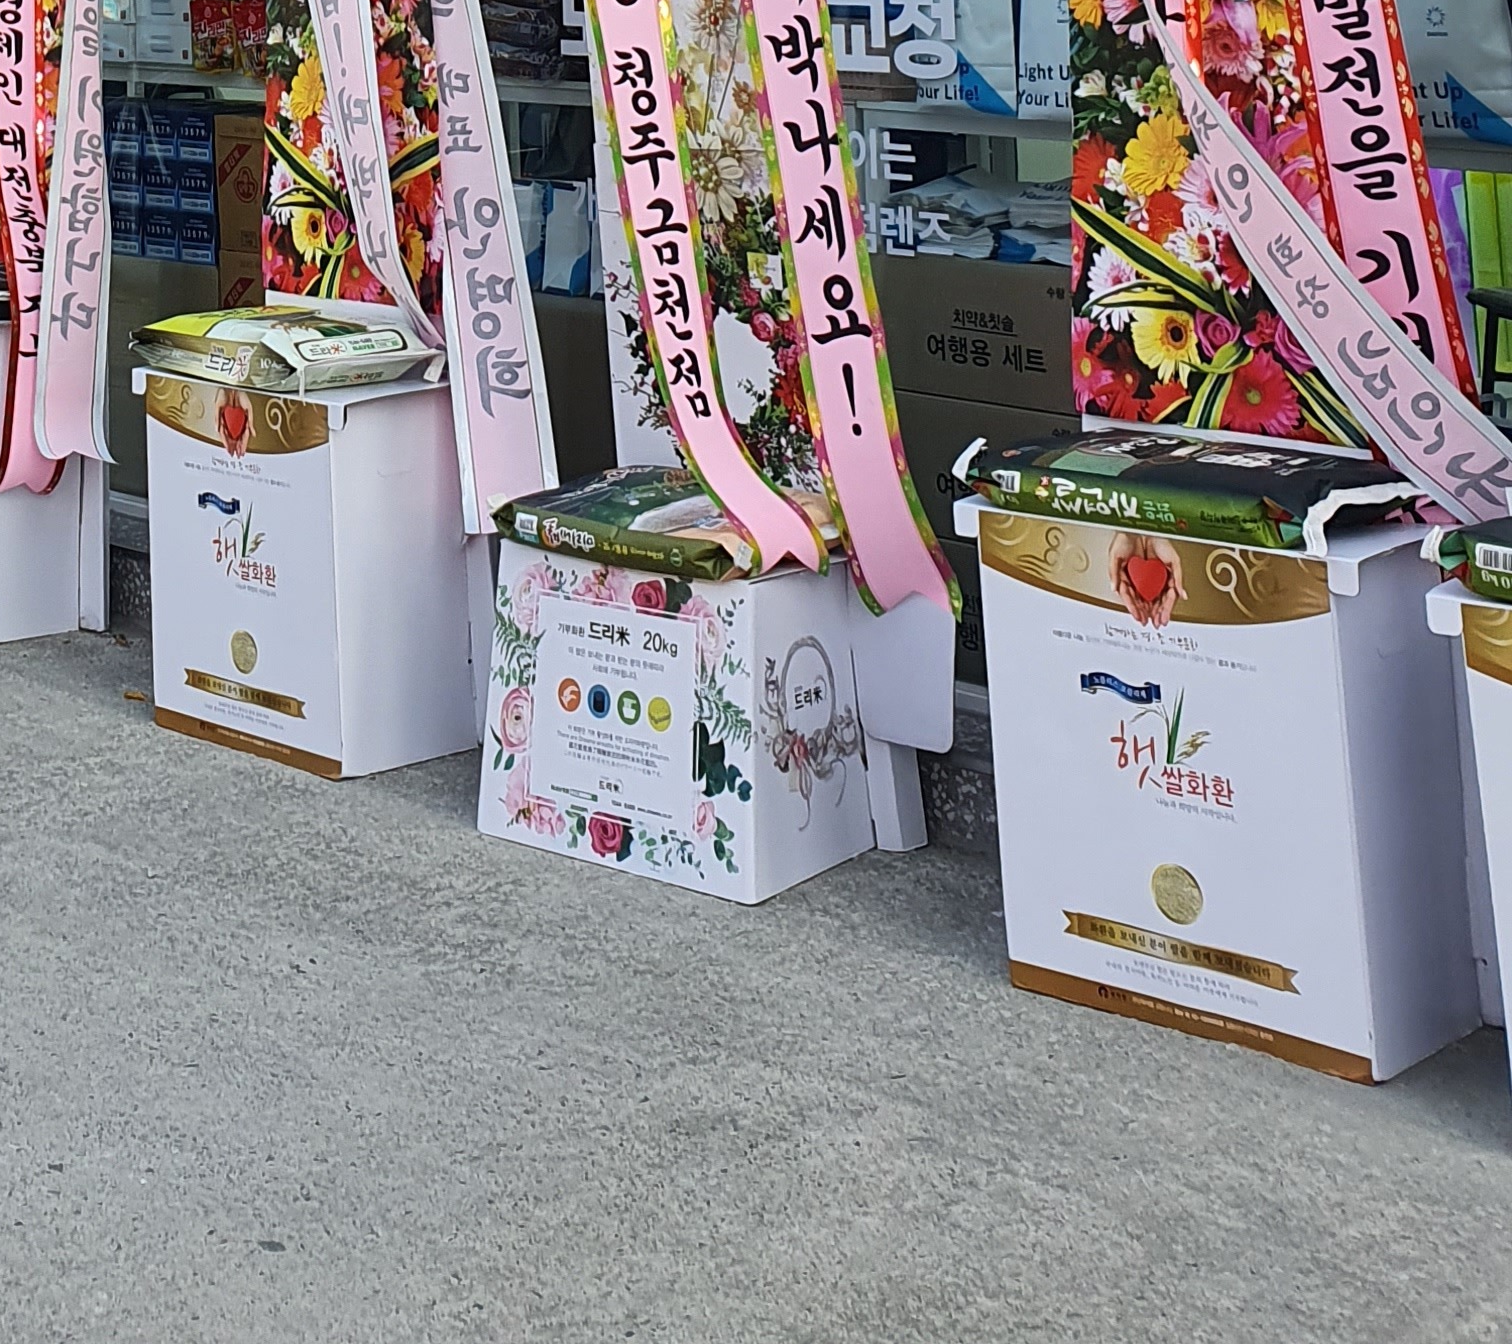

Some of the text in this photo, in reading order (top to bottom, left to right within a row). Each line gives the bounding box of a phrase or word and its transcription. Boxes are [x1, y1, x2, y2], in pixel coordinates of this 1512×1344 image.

[943, 83, 979, 102] Life!
[1431, 76, 1463, 99] Up
[952, 308, 1016, 333] 치약&칫솔
[926, 335, 1048, 374] 여행용 세트
[642, 630, 678, 658] 20kg
